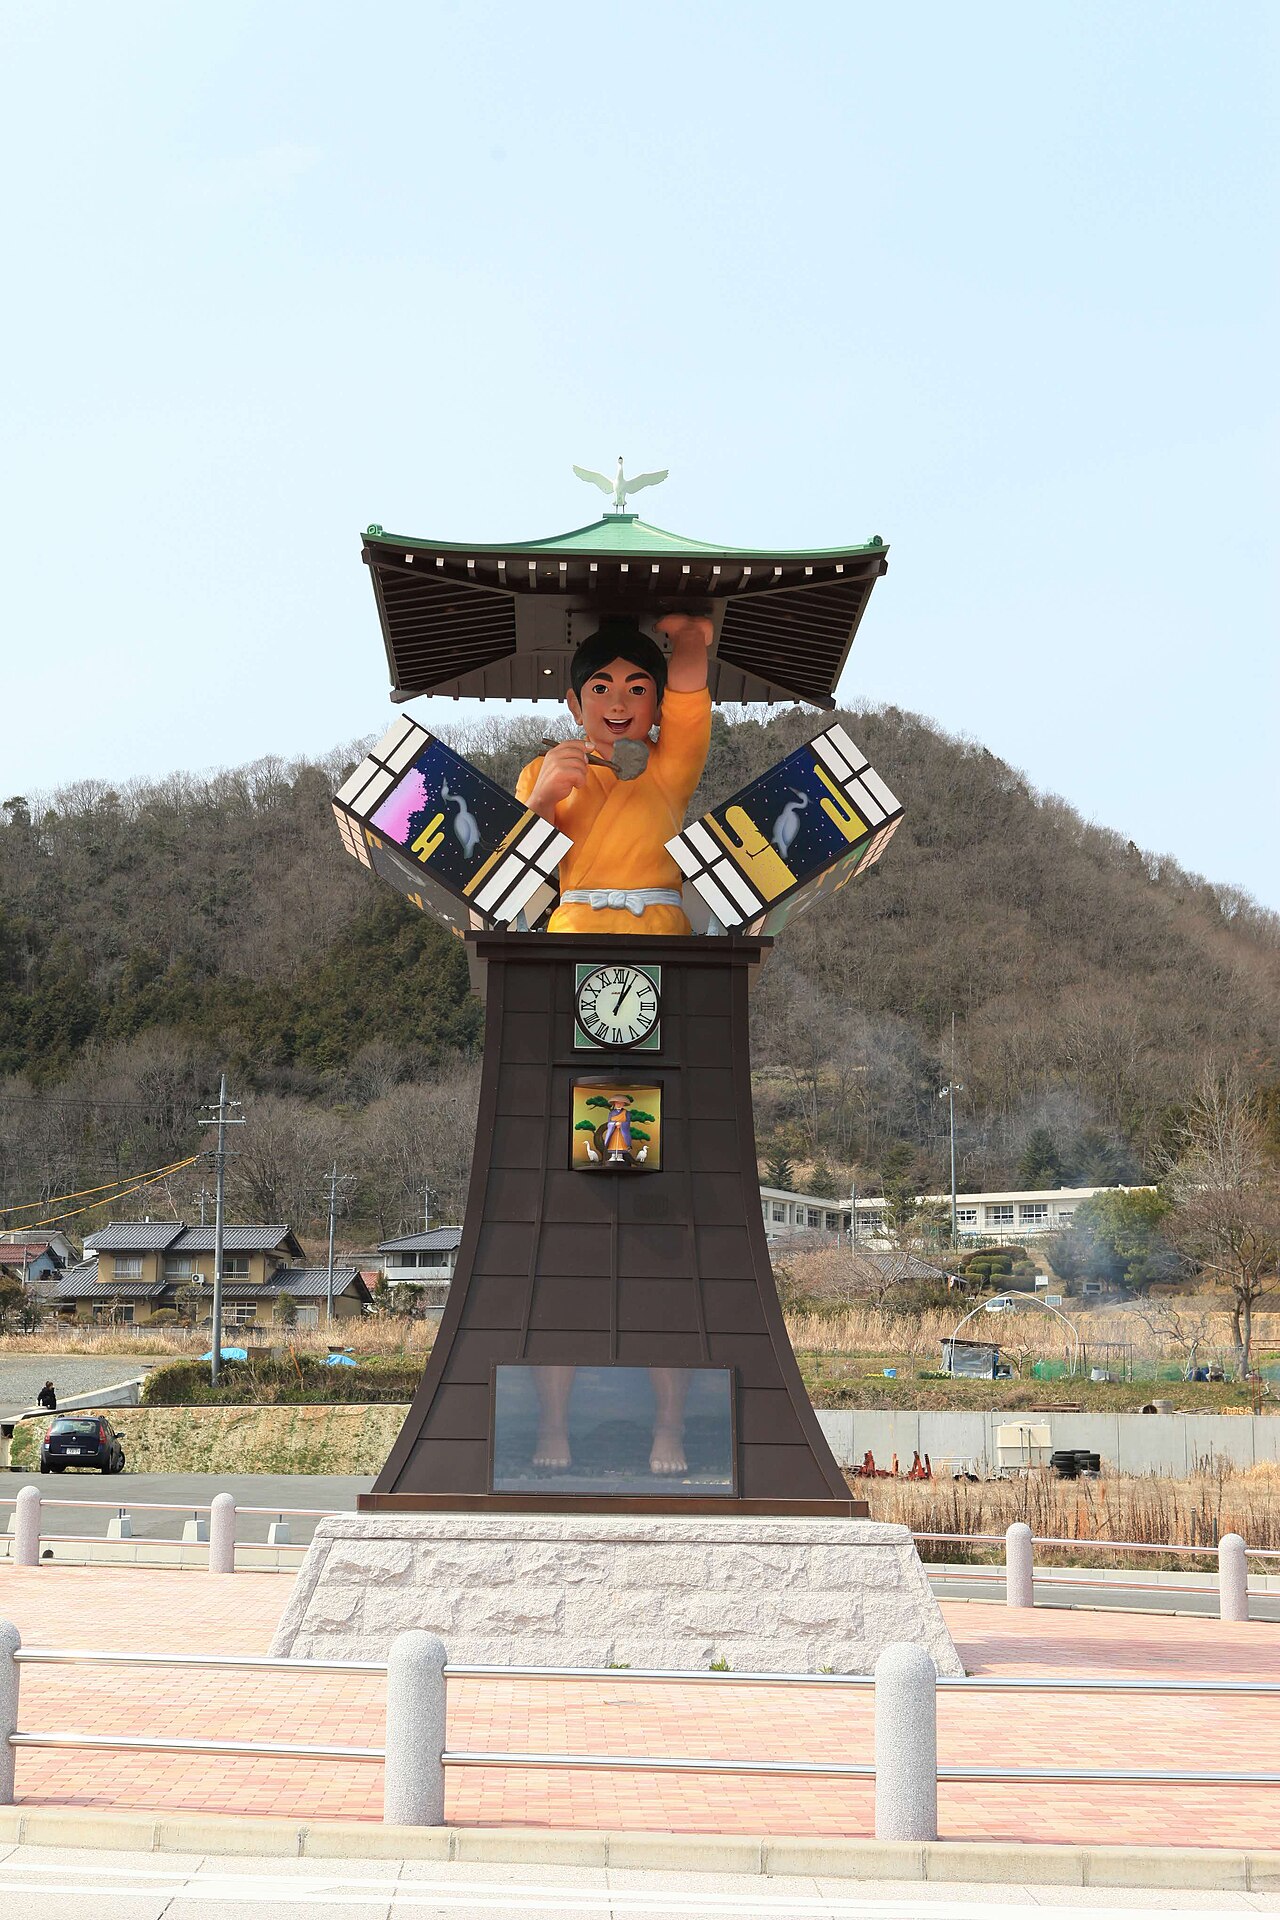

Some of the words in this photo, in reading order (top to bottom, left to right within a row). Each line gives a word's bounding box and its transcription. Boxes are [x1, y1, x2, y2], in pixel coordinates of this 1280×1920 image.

[596, 972, 612, 989] XI
[613, 969, 625, 984] XII
[585, 983, 602, 998] X
[637, 985, 652, 998] II
[581, 999, 597, 1011] IX
[640, 1001, 656, 1012] III
[583, 1012, 600, 1028] VIII
[636, 1013, 652, 1029] IV
[594, 1022, 610, 1040] VII
[612, 1028, 624, 1043] VI
[628, 1025, 640, 1040] V
